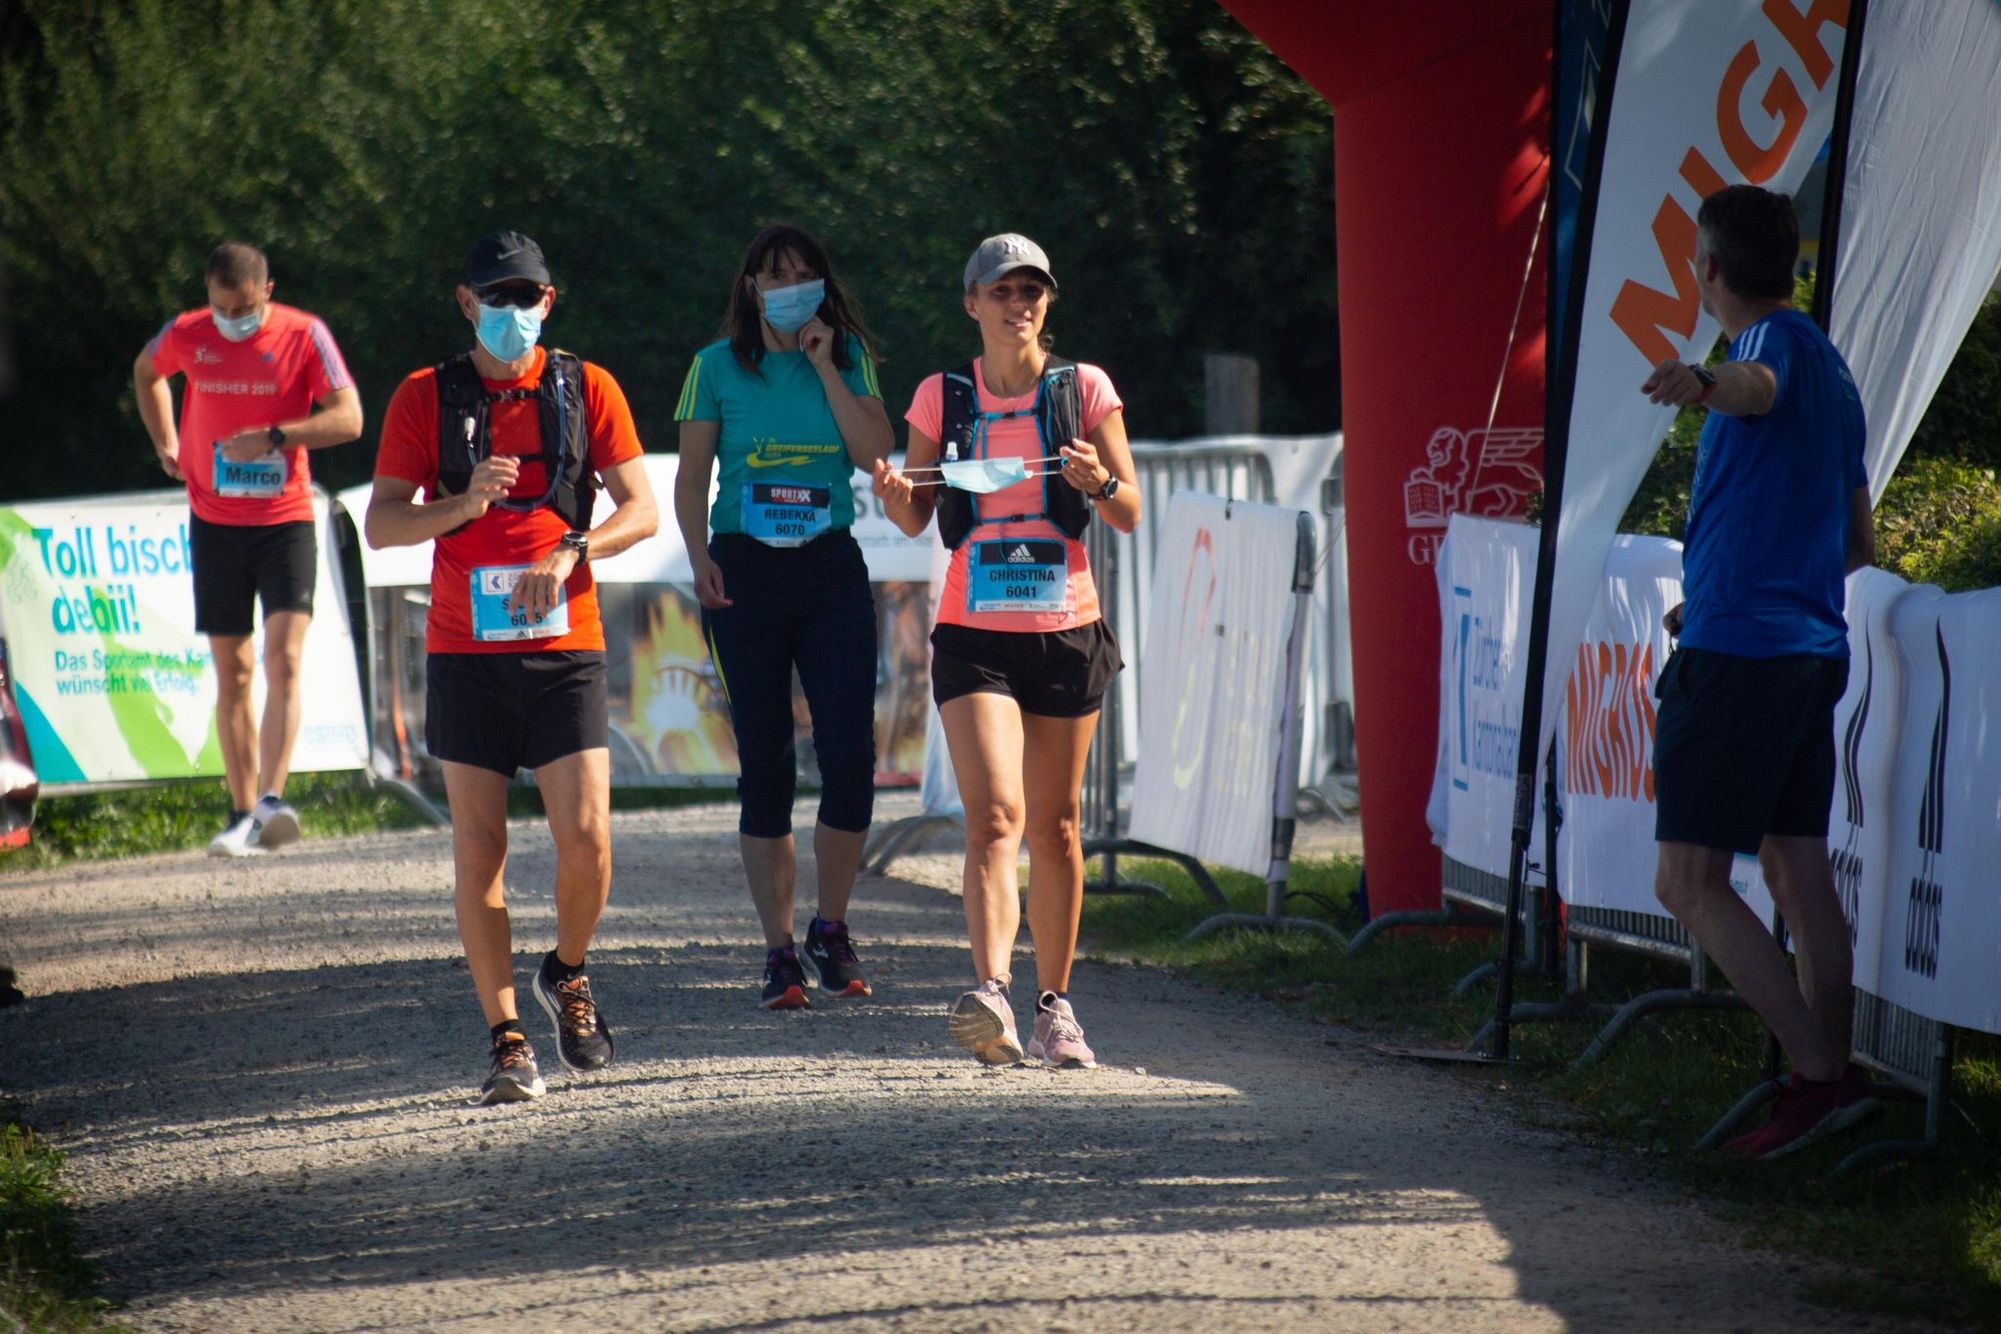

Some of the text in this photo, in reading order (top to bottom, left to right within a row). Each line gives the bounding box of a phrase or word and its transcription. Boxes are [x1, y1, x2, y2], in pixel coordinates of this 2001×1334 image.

[194, 381, 277, 397] FINISHER 2019
[225, 467, 281, 486] Marco
[764, 508, 816, 522] REBEKKA
[775, 523, 805, 536] 6070
[31, 526, 98, 577] Toll
[1007, 556, 1035, 564] adidas
[989, 569, 1056, 582] CHRISTINA
[1006, 585, 1037, 598] 6041
[52, 583, 141, 635] debii!
[511, 612, 543, 627] 605
[55, 650, 88, 671] Das
[56, 673, 128, 696] wünscht
